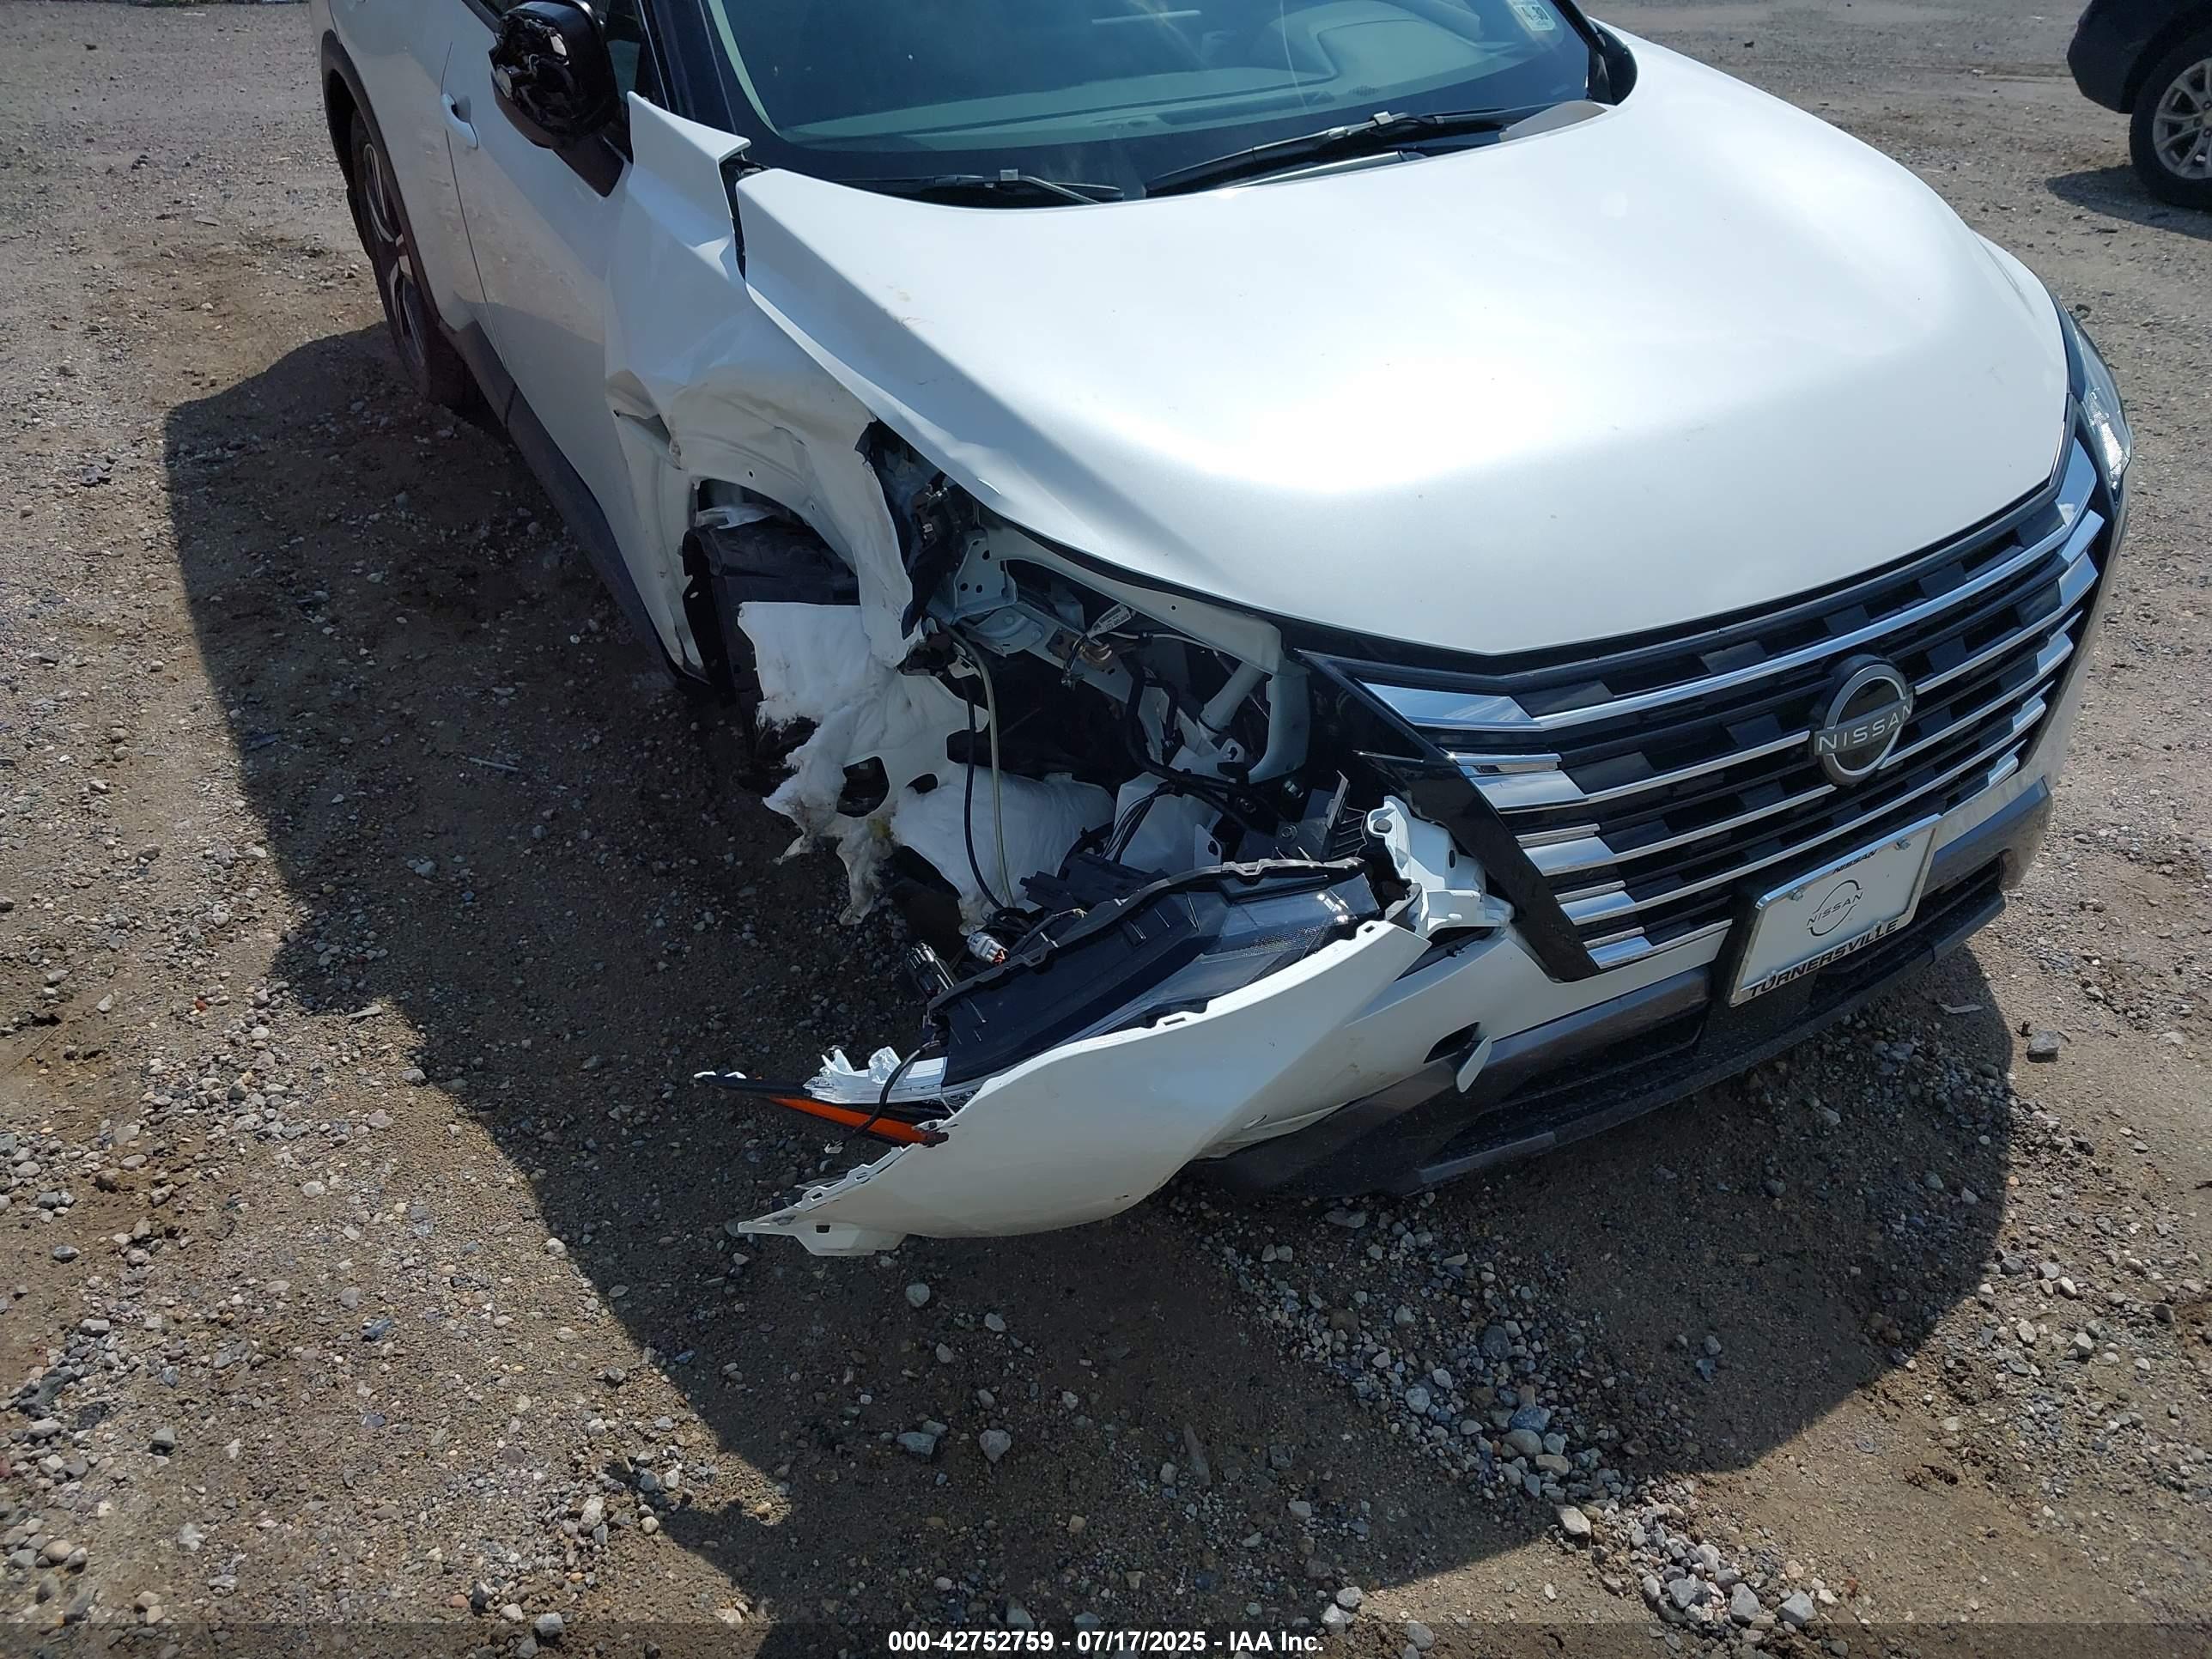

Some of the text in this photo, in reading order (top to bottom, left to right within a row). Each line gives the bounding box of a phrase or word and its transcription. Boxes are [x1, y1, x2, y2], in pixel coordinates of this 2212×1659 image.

[1819, 693, 1913, 751] NISSAN
[1832, 849, 1878, 874] NISSAN
[1806, 891, 1863, 927] NISSAN
[1751, 919, 1899, 996] TURNERSVILLE
